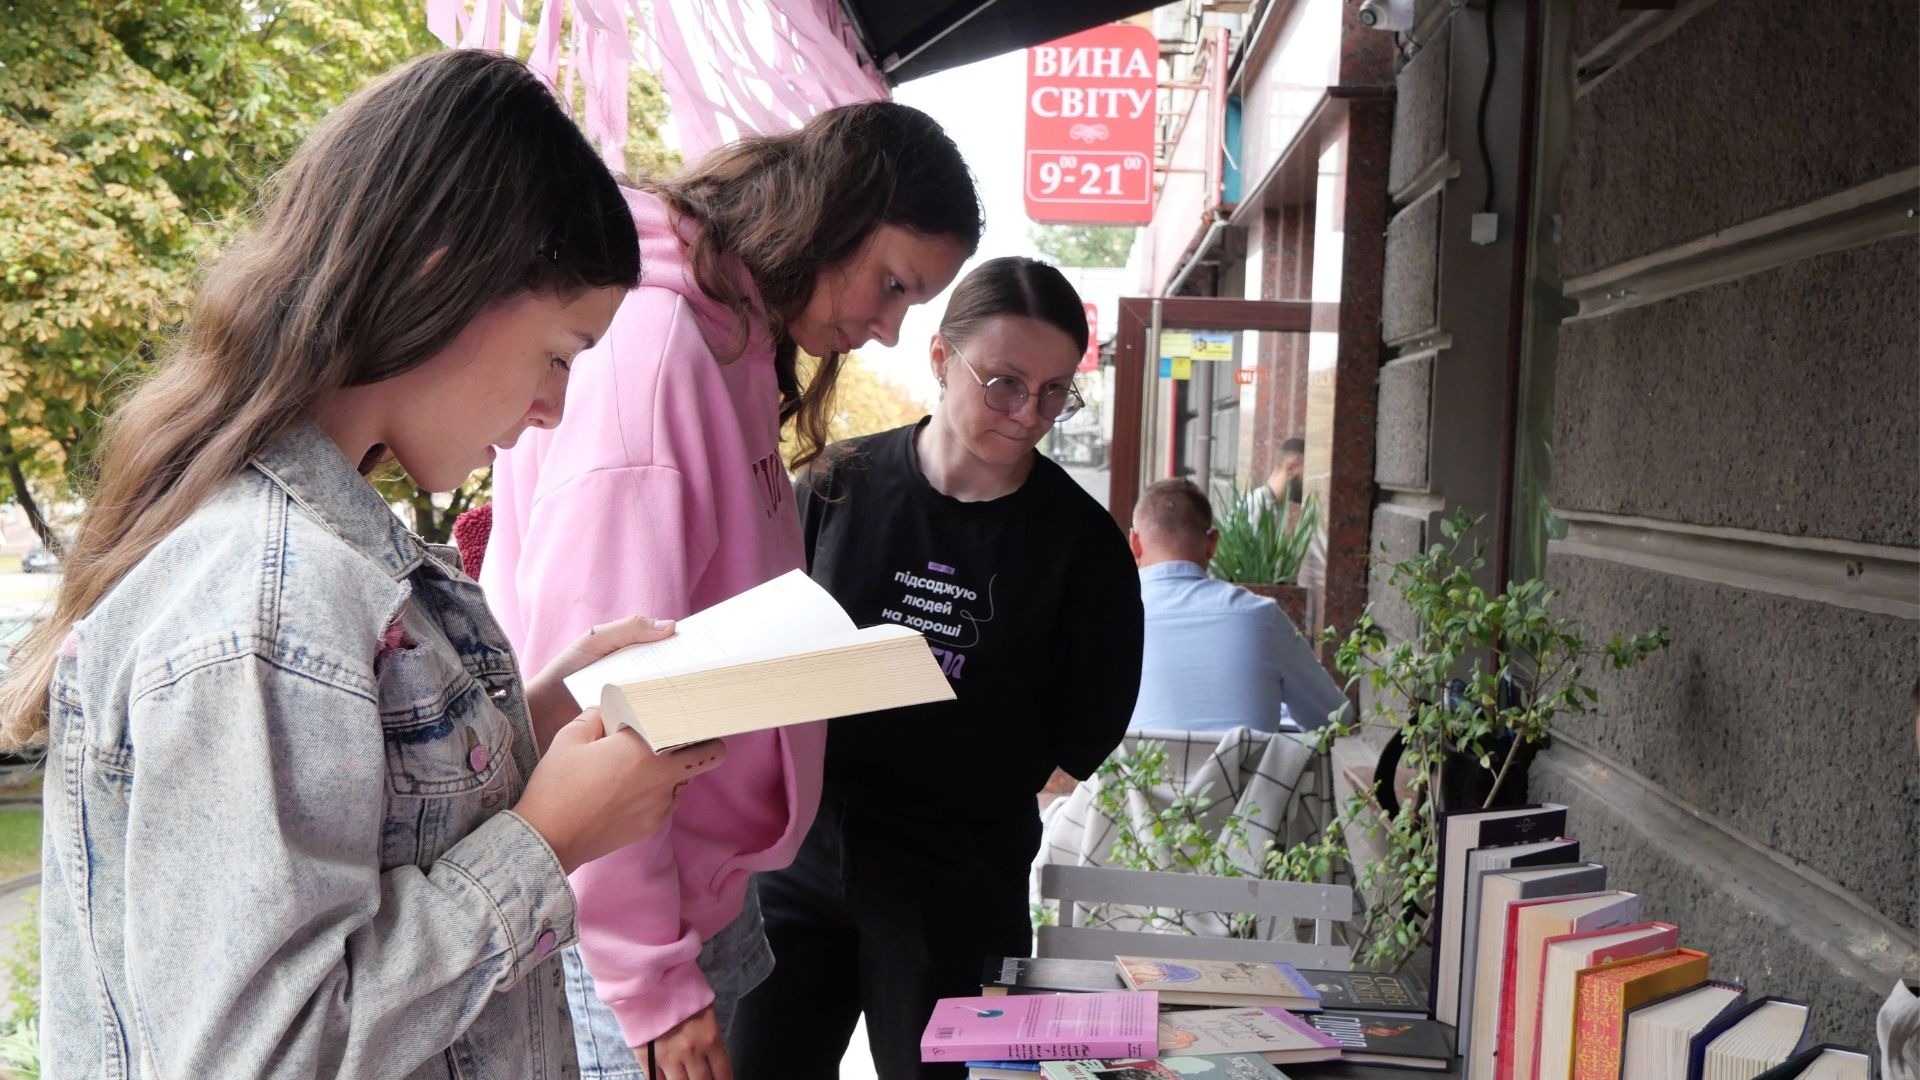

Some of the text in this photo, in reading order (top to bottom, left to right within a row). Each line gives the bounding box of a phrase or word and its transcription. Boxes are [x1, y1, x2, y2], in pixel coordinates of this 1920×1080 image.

[1033, 47, 1152, 78] ВИНА
[1031, 87, 1152, 118] СВІТУ
[894, 571, 977, 600] підсаджую
[902, 594, 953, 615] людей
[881, 608, 962, 637] на хороші
